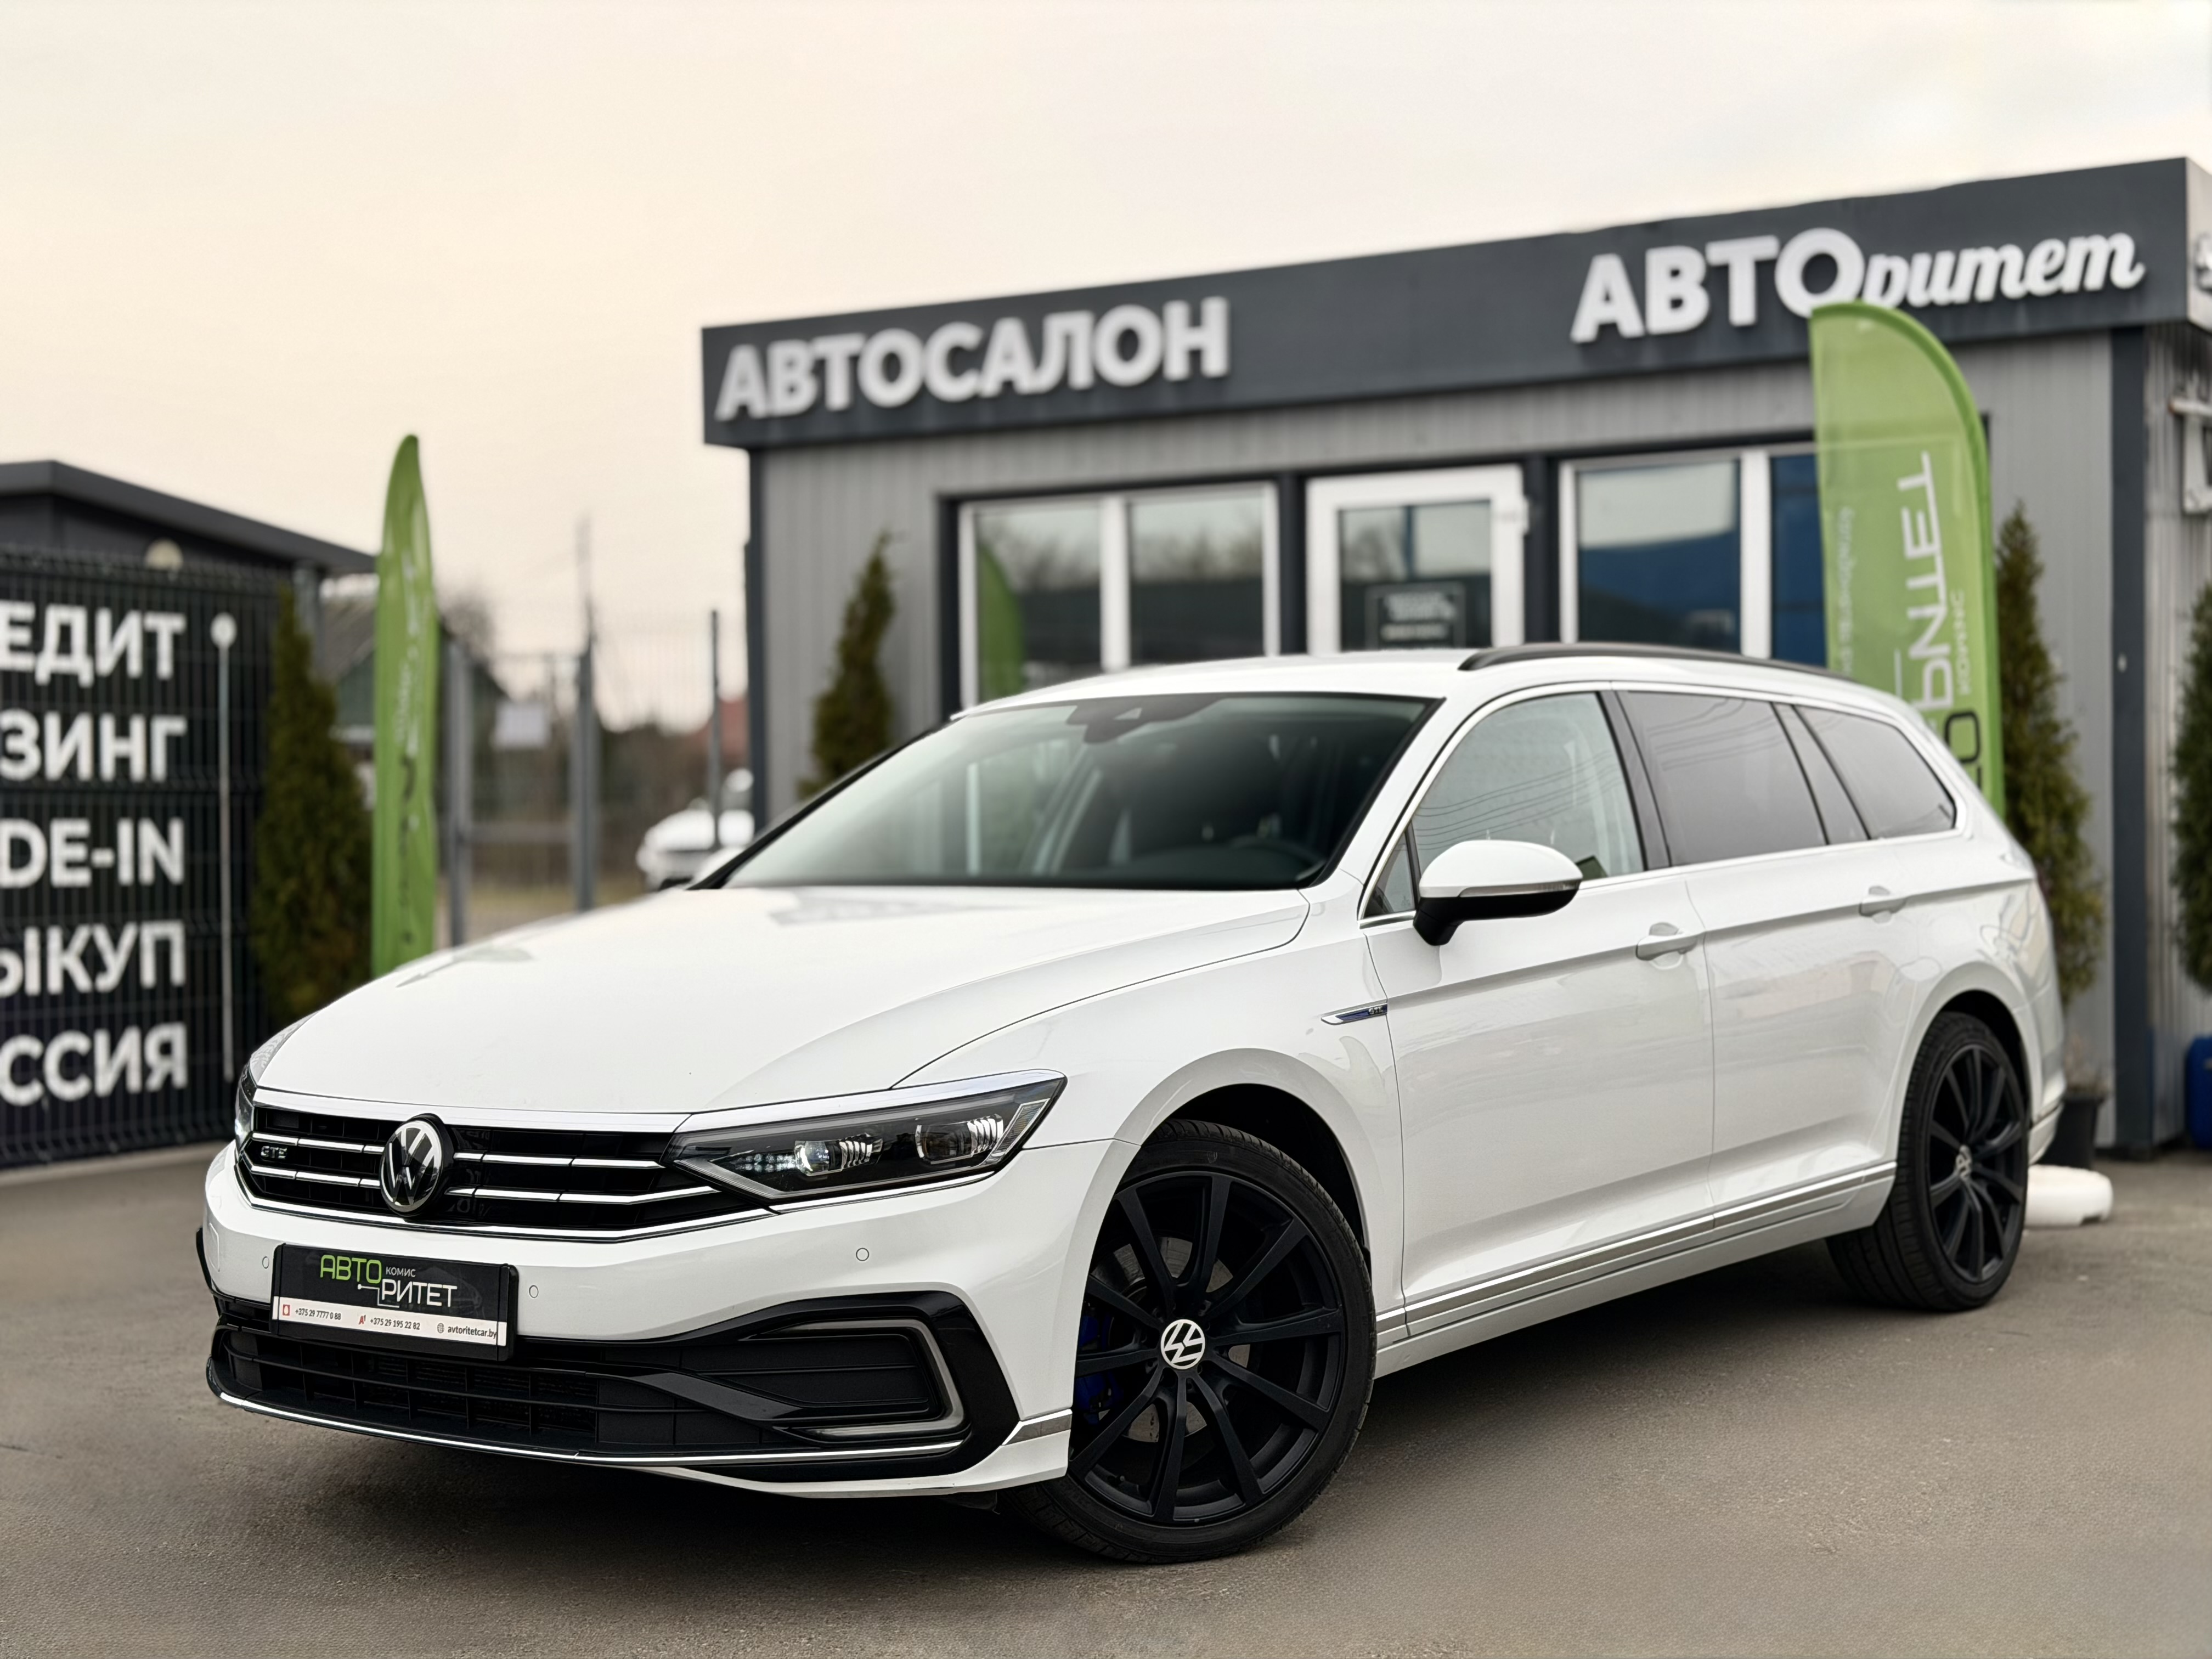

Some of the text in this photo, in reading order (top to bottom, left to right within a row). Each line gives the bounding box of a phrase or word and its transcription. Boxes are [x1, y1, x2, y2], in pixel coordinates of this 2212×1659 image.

[714, 295, 1229, 421] АВТОСАЛОН
[261, 1145, 288, 1160] GTE
[320, 1254, 382, 1284] АВТО
[386, 1266, 416, 1278] КОМИС
[382, 1278, 458, 1307] РИТЕТ
[295, 1308, 308, 1317] +375
[309, 1309, 315, 1317] 29
[370, 1317, 384, 1326] +375
[393, 1319, 403, 1328] 195
[404, 1321, 411, 1329] 22
[413, 1322, 420, 1330] 82
[447, 1325, 497, 1340] avtoritetcar.by
